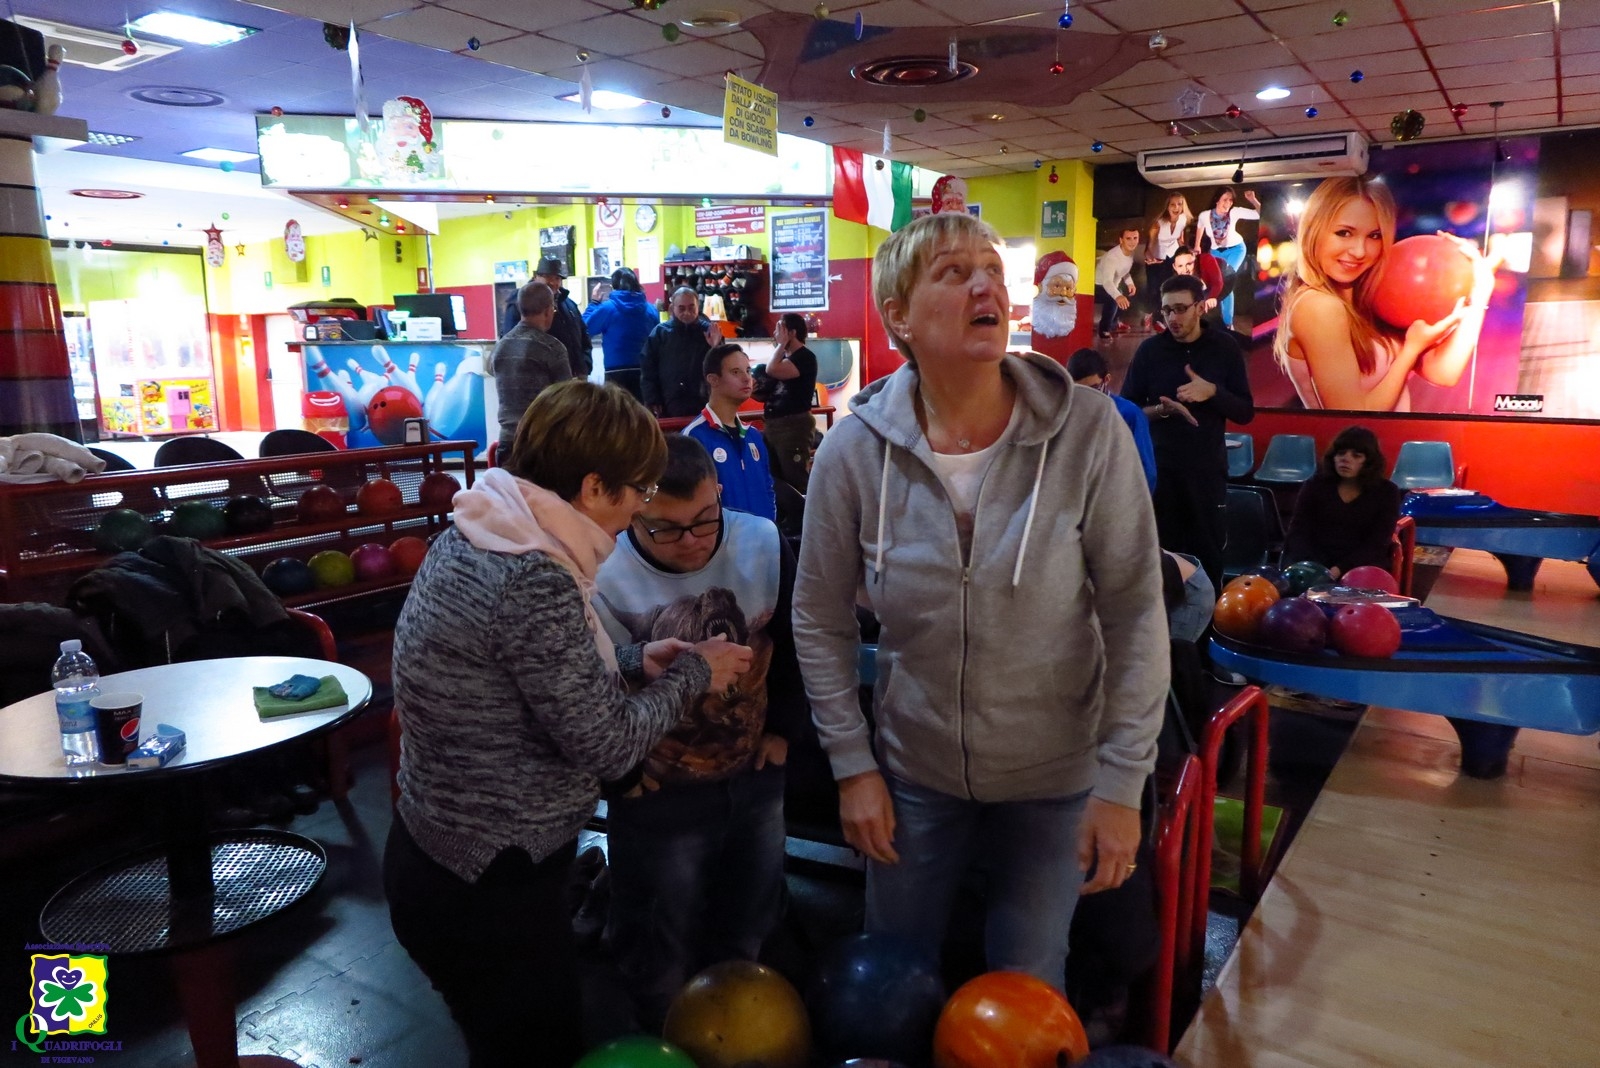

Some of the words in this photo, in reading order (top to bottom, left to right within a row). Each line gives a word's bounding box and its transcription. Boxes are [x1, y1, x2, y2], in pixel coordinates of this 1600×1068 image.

[731, 94, 751, 109] DALLA
[753, 102, 771, 116] ZONA
[753, 91, 776, 108] USCIRE
[736, 107, 743, 117] DI
[745, 110, 766, 125] GIOCO
[729, 116, 744, 129] CON
[746, 122, 772, 139] SCARPE
[730, 128, 739, 138] DA
[741, 132, 773, 149] BOWLING
